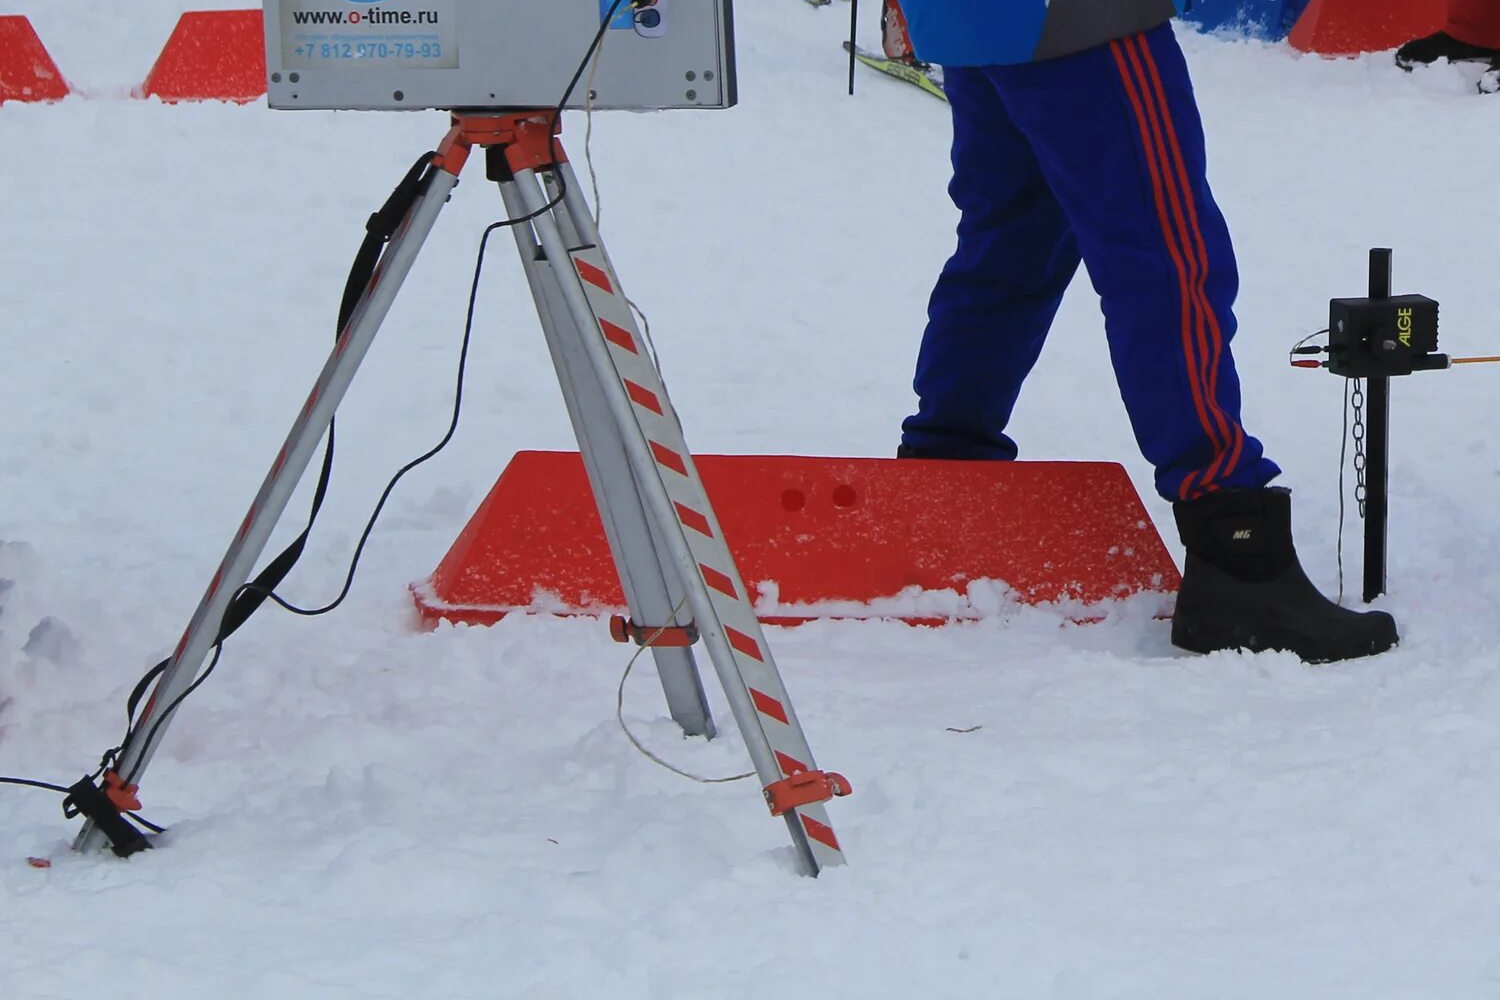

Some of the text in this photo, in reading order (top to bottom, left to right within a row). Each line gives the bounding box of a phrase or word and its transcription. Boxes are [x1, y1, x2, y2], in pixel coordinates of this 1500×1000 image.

[293, 7, 438, 24] www.o-time.ru
[294, 43, 314, 58] +7
[321, 42, 352, 58] 812
[1398, 308, 1412, 347] ALGE
